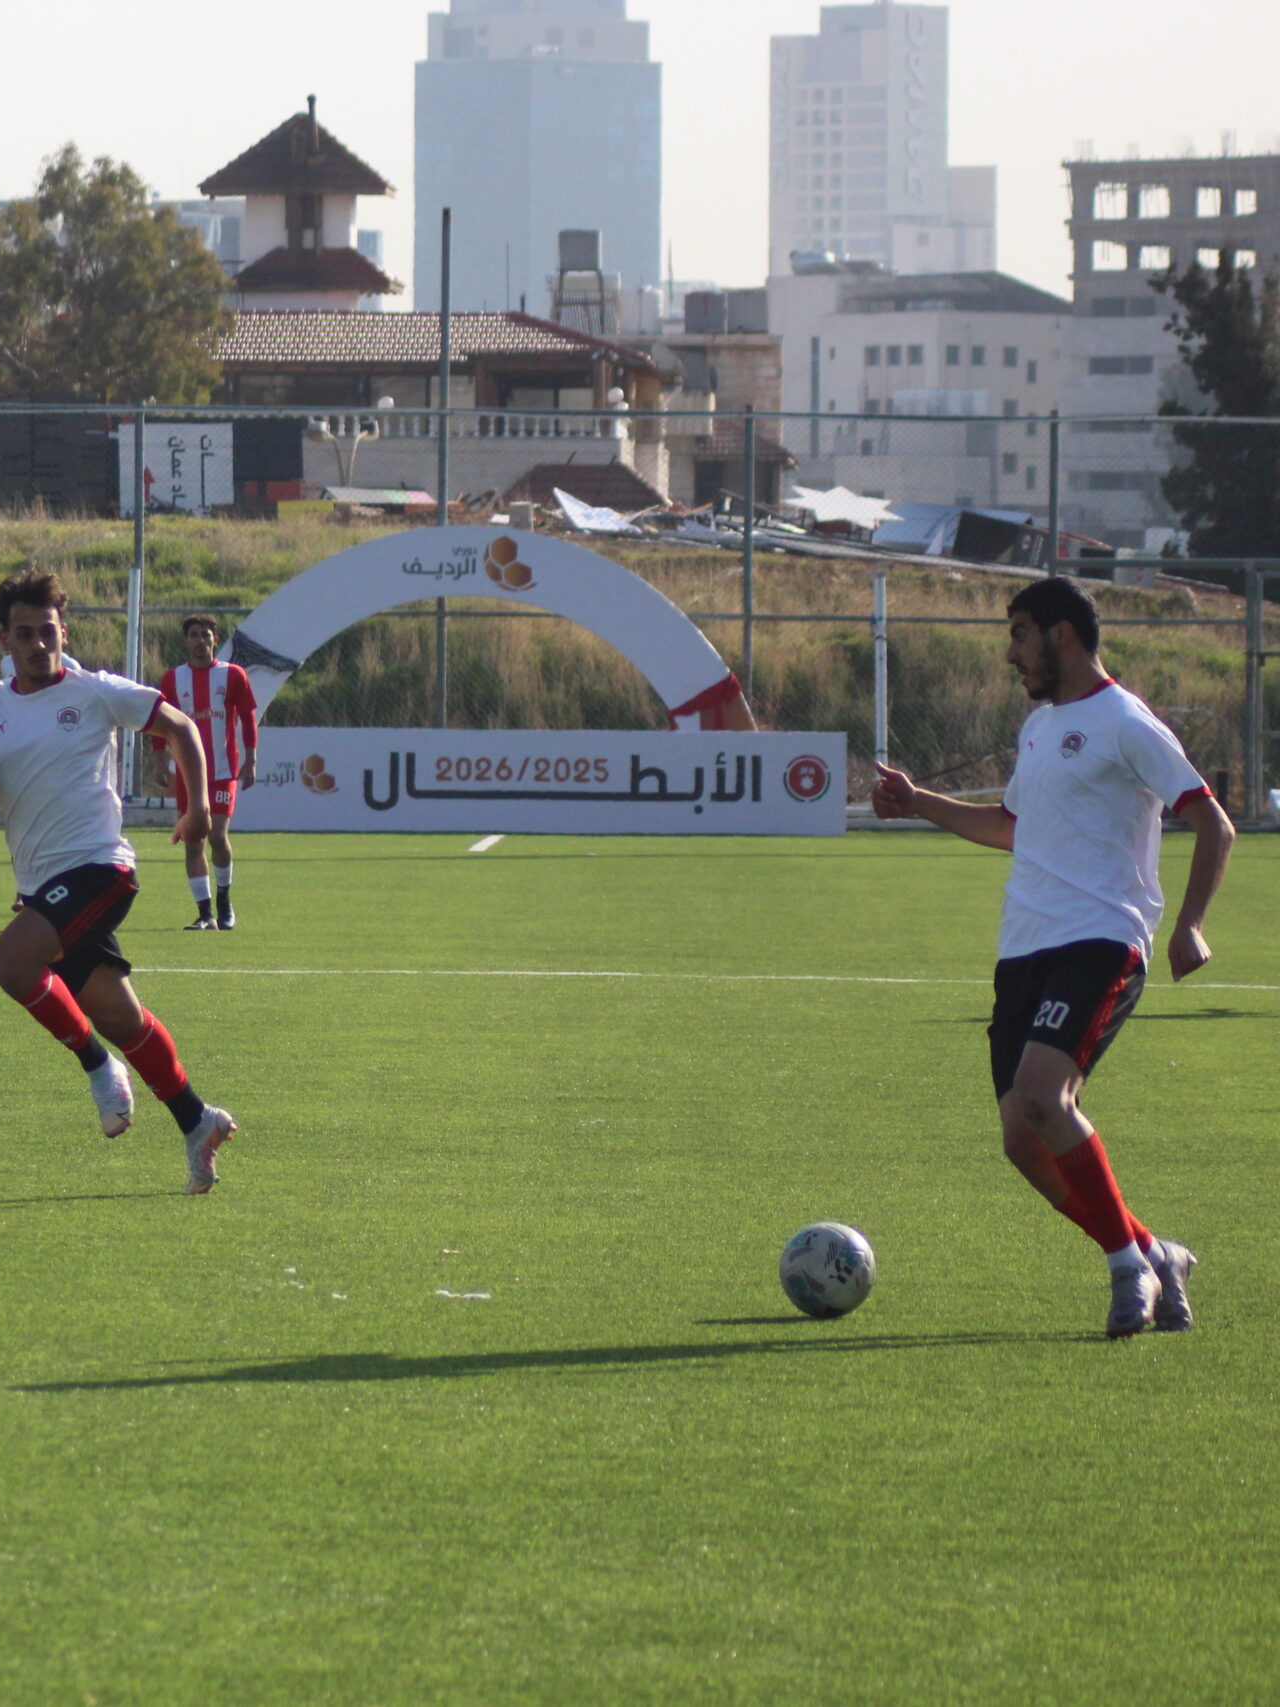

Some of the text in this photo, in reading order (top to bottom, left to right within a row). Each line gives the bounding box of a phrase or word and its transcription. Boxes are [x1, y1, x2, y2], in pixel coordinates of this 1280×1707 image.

[168, 436, 186, 478] عمان
[402, 557, 476, 580] الرديف
[256, 769, 295, 787] الردي
[363, 751, 763, 814] الأبطال
[436, 757, 609, 783] 2026/2025
[46, 885, 68, 904] 8
[1033, 1000, 1070, 1029] 20
